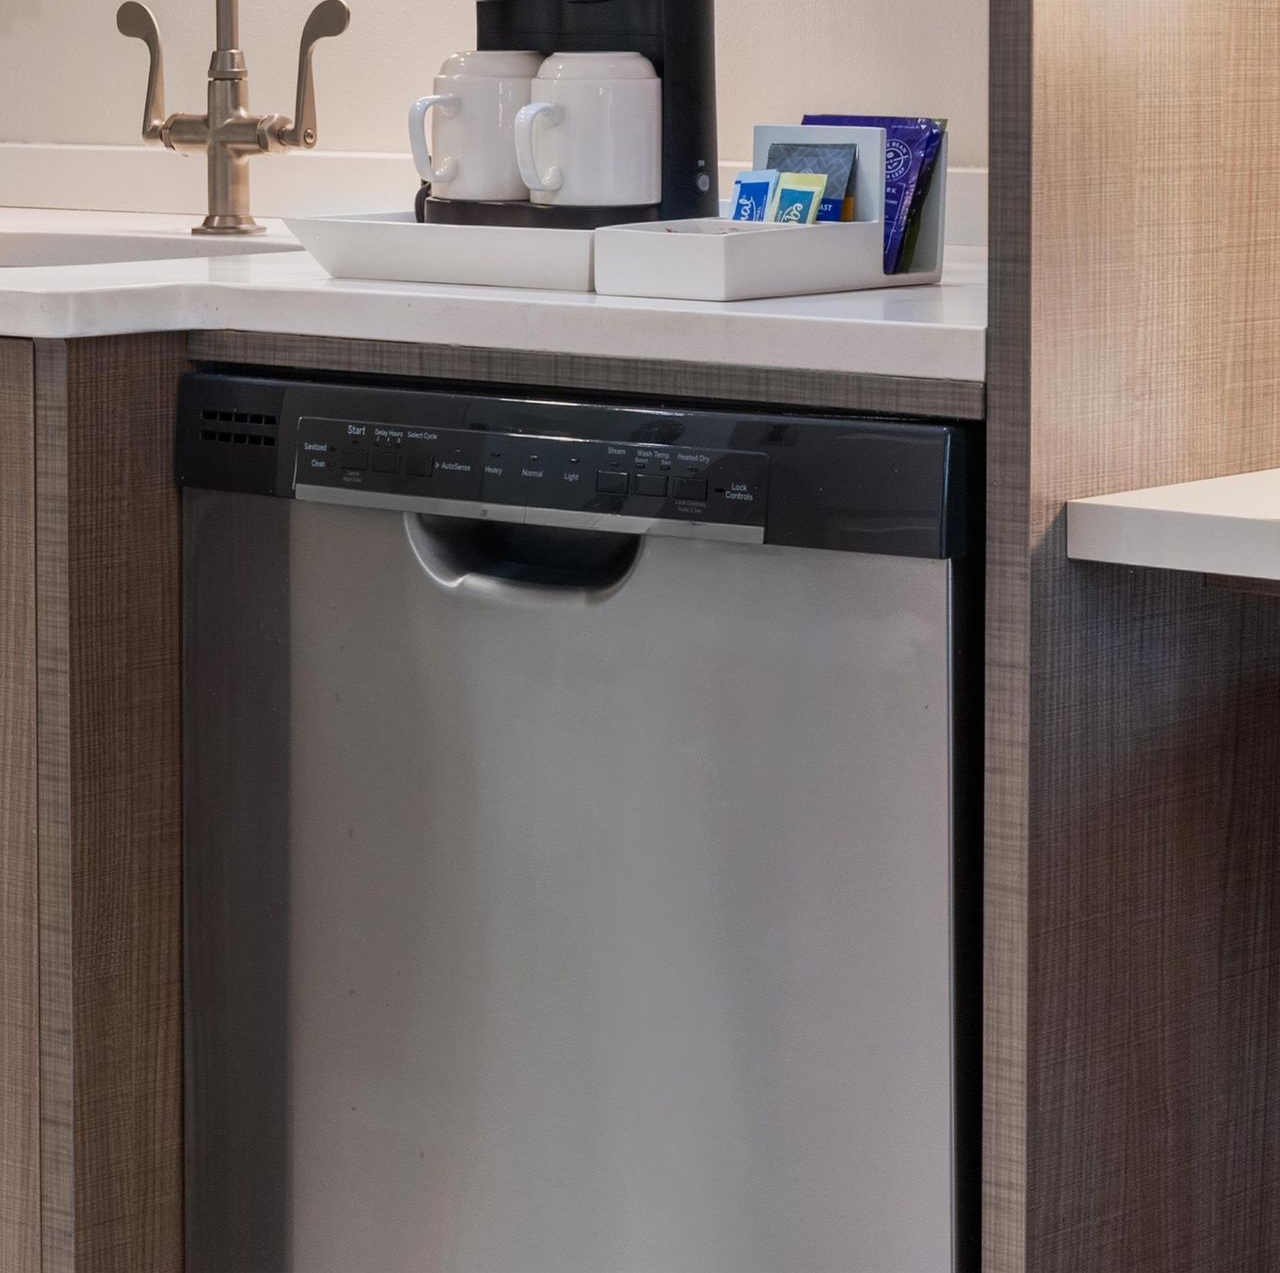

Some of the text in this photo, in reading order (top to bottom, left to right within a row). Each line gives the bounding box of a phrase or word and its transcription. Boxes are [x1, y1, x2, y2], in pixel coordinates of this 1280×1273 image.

[891, 141, 907, 154] BEAN
[892, 167, 905, 179] LEAF
[347, 425, 366, 435] Start
[374, 429, 403, 438] Delay Hours
[407, 431, 438, 441] Select Cycle
[304, 442, 328, 452] Sanitized
[608, 447, 626, 455] Steam
[637, 449, 670, 460] Wash Temp
[677, 453, 710, 464] Heated Dry
[311, 459, 326, 467] Clean
[440, 462, 471, 472] AutoSense
[484, 466, 503, 476] Heavy
[521, 469, 544, 478] Normal
[564, 472, 580, 482] Light
[731, 482, 747, 491] Lock
[725, 492, 753, 502] Controls
